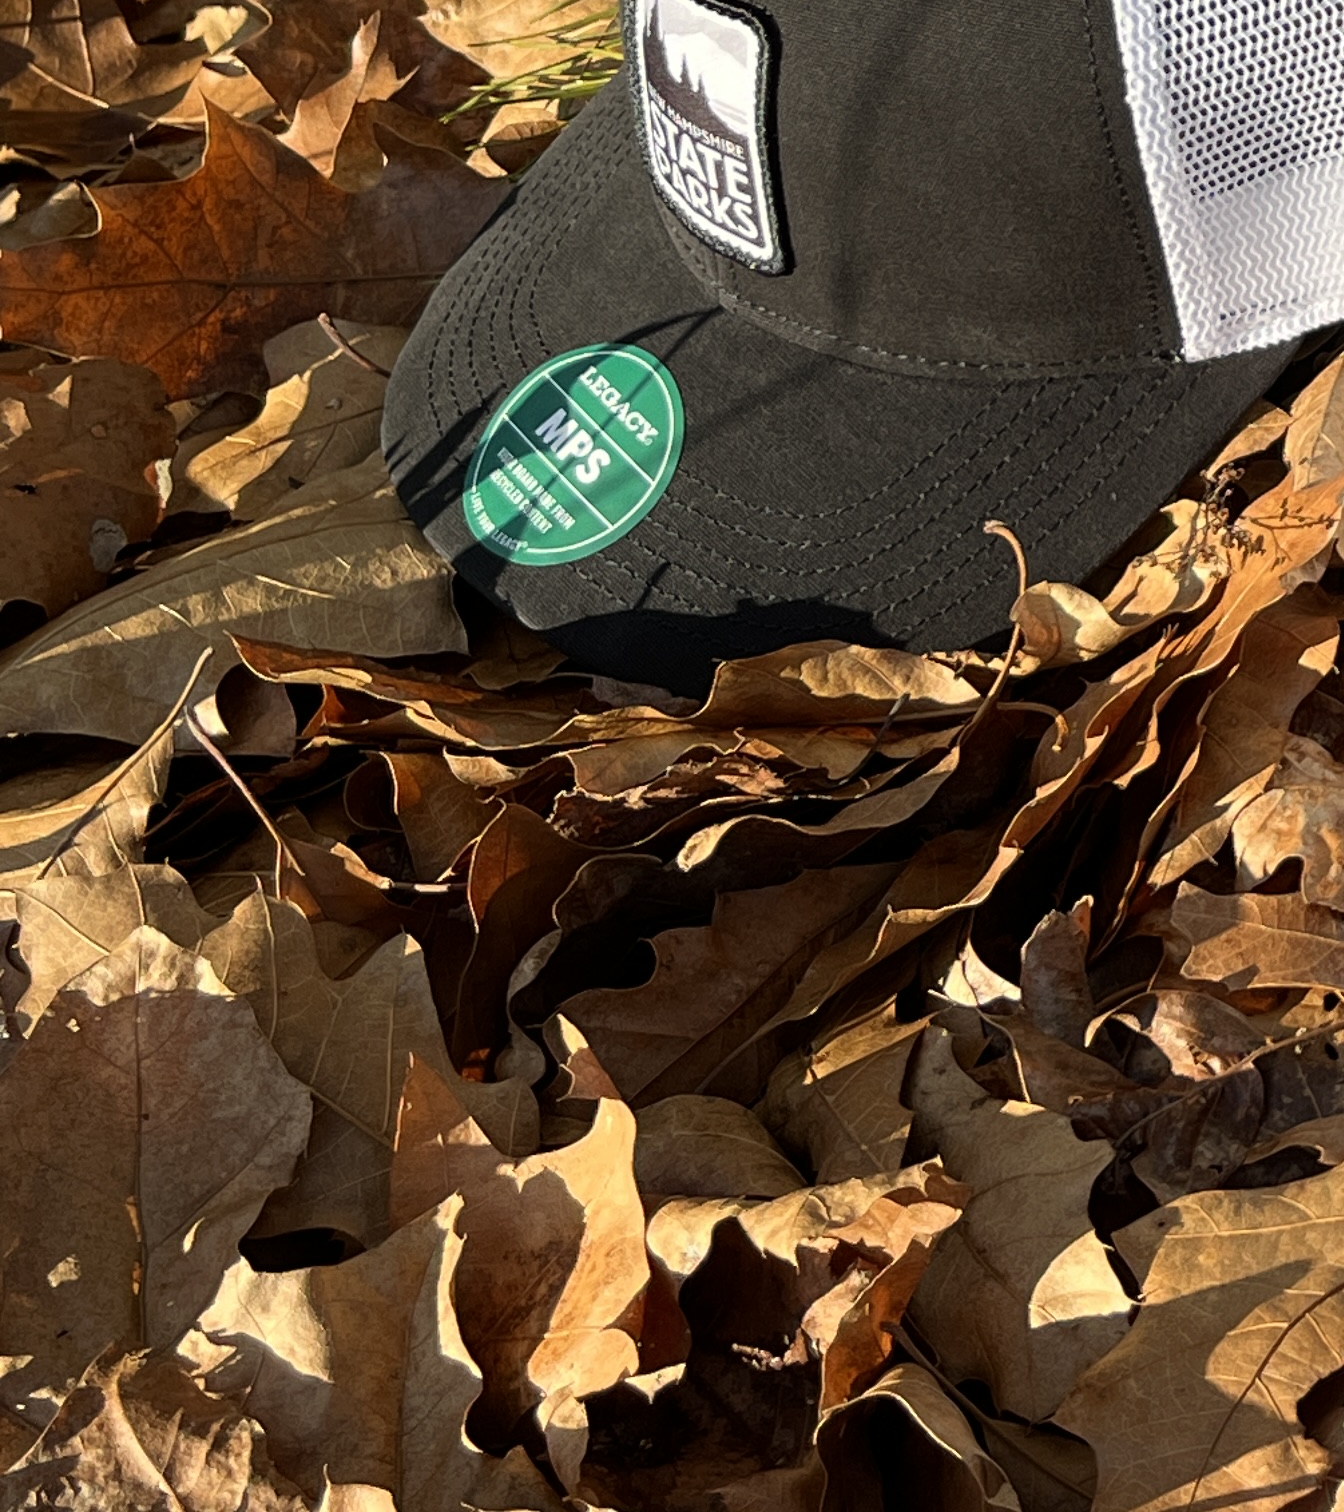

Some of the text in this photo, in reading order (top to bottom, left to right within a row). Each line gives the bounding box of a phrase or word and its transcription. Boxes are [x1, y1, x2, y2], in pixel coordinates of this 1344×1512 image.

[651, 100, 753, 204] STATE
[667, 105, 746, 159] HAMPSHIRE
[655, 144, 759, 238] PARKS
[535, 408, 611, 484] MPS
